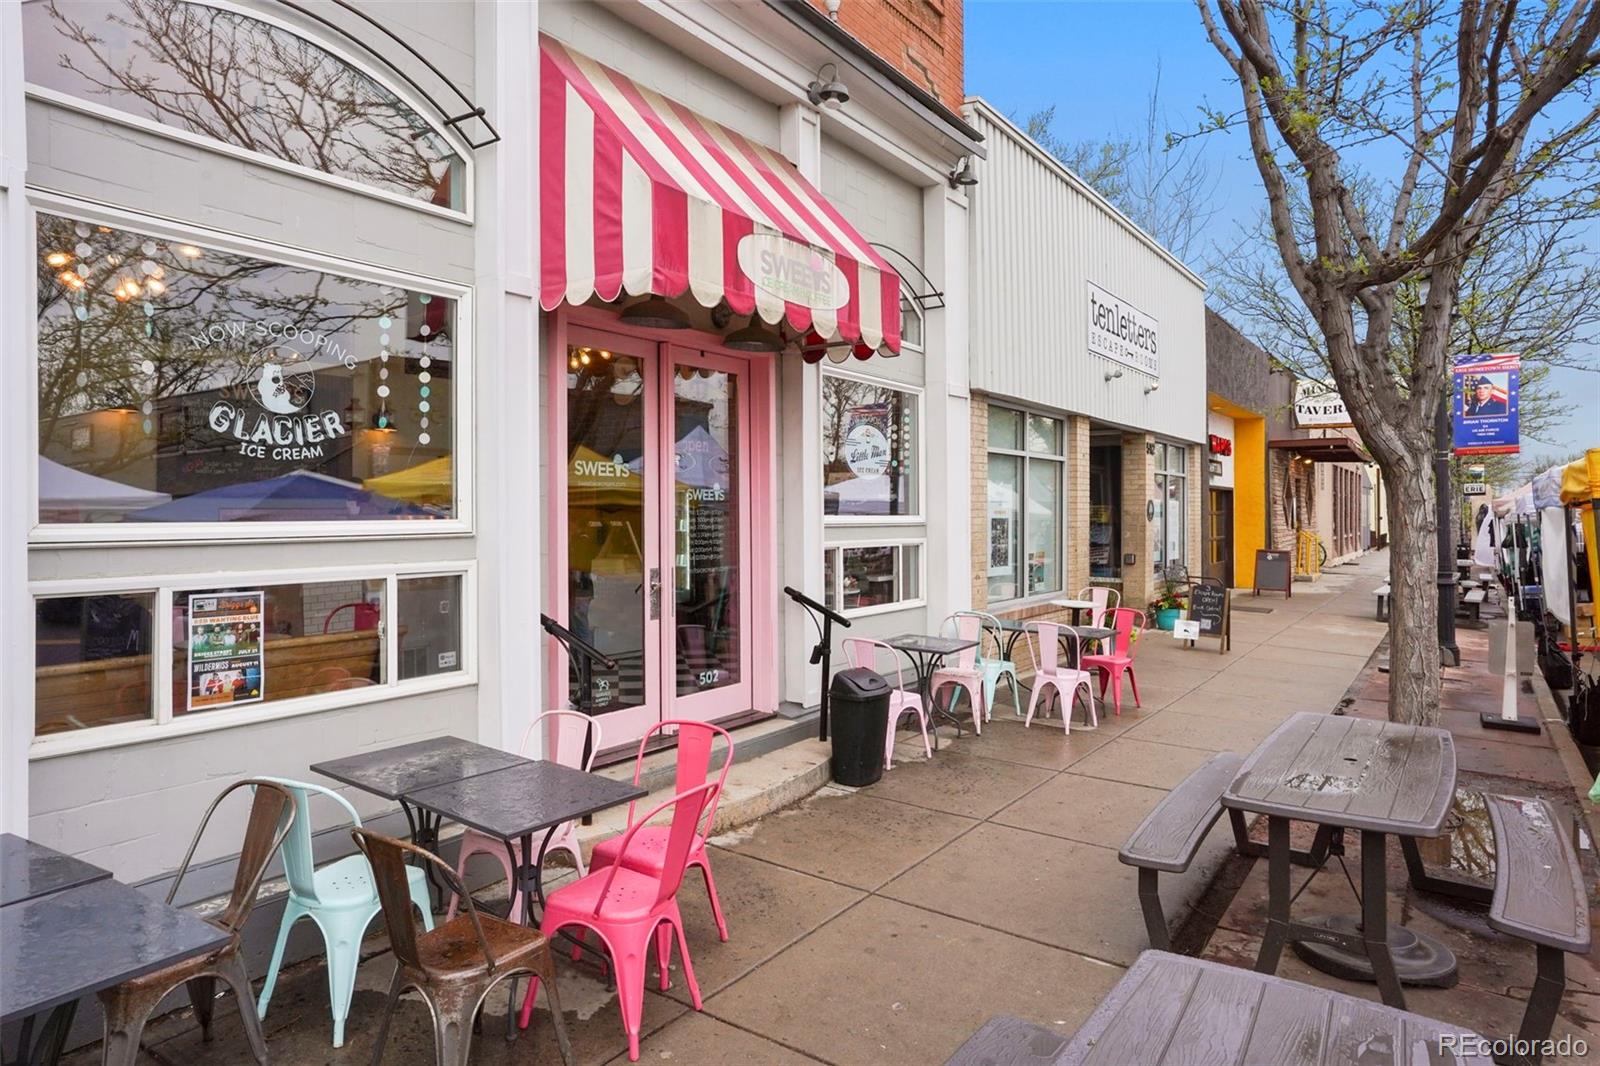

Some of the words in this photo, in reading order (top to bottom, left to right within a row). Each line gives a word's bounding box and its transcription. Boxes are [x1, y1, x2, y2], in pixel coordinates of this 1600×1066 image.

[1091, 291, 1157, 354] tenletters
[190, 321, 246, 350] NOW
[256, 321, 359, 370] SCOOPING
[1091, 331, 1124, 357] ESCAPE
[1295, 404, 1347, 416] TAVER
[208, 400, 345, 446] GLACIER
[239, 442, 266, 458] ICE
[272, 446, 323, 461] CREAM
[850, 448, 869, 463] Little
[871, 445, 887, 459] Man
[699, 669, 719, 685] 502
